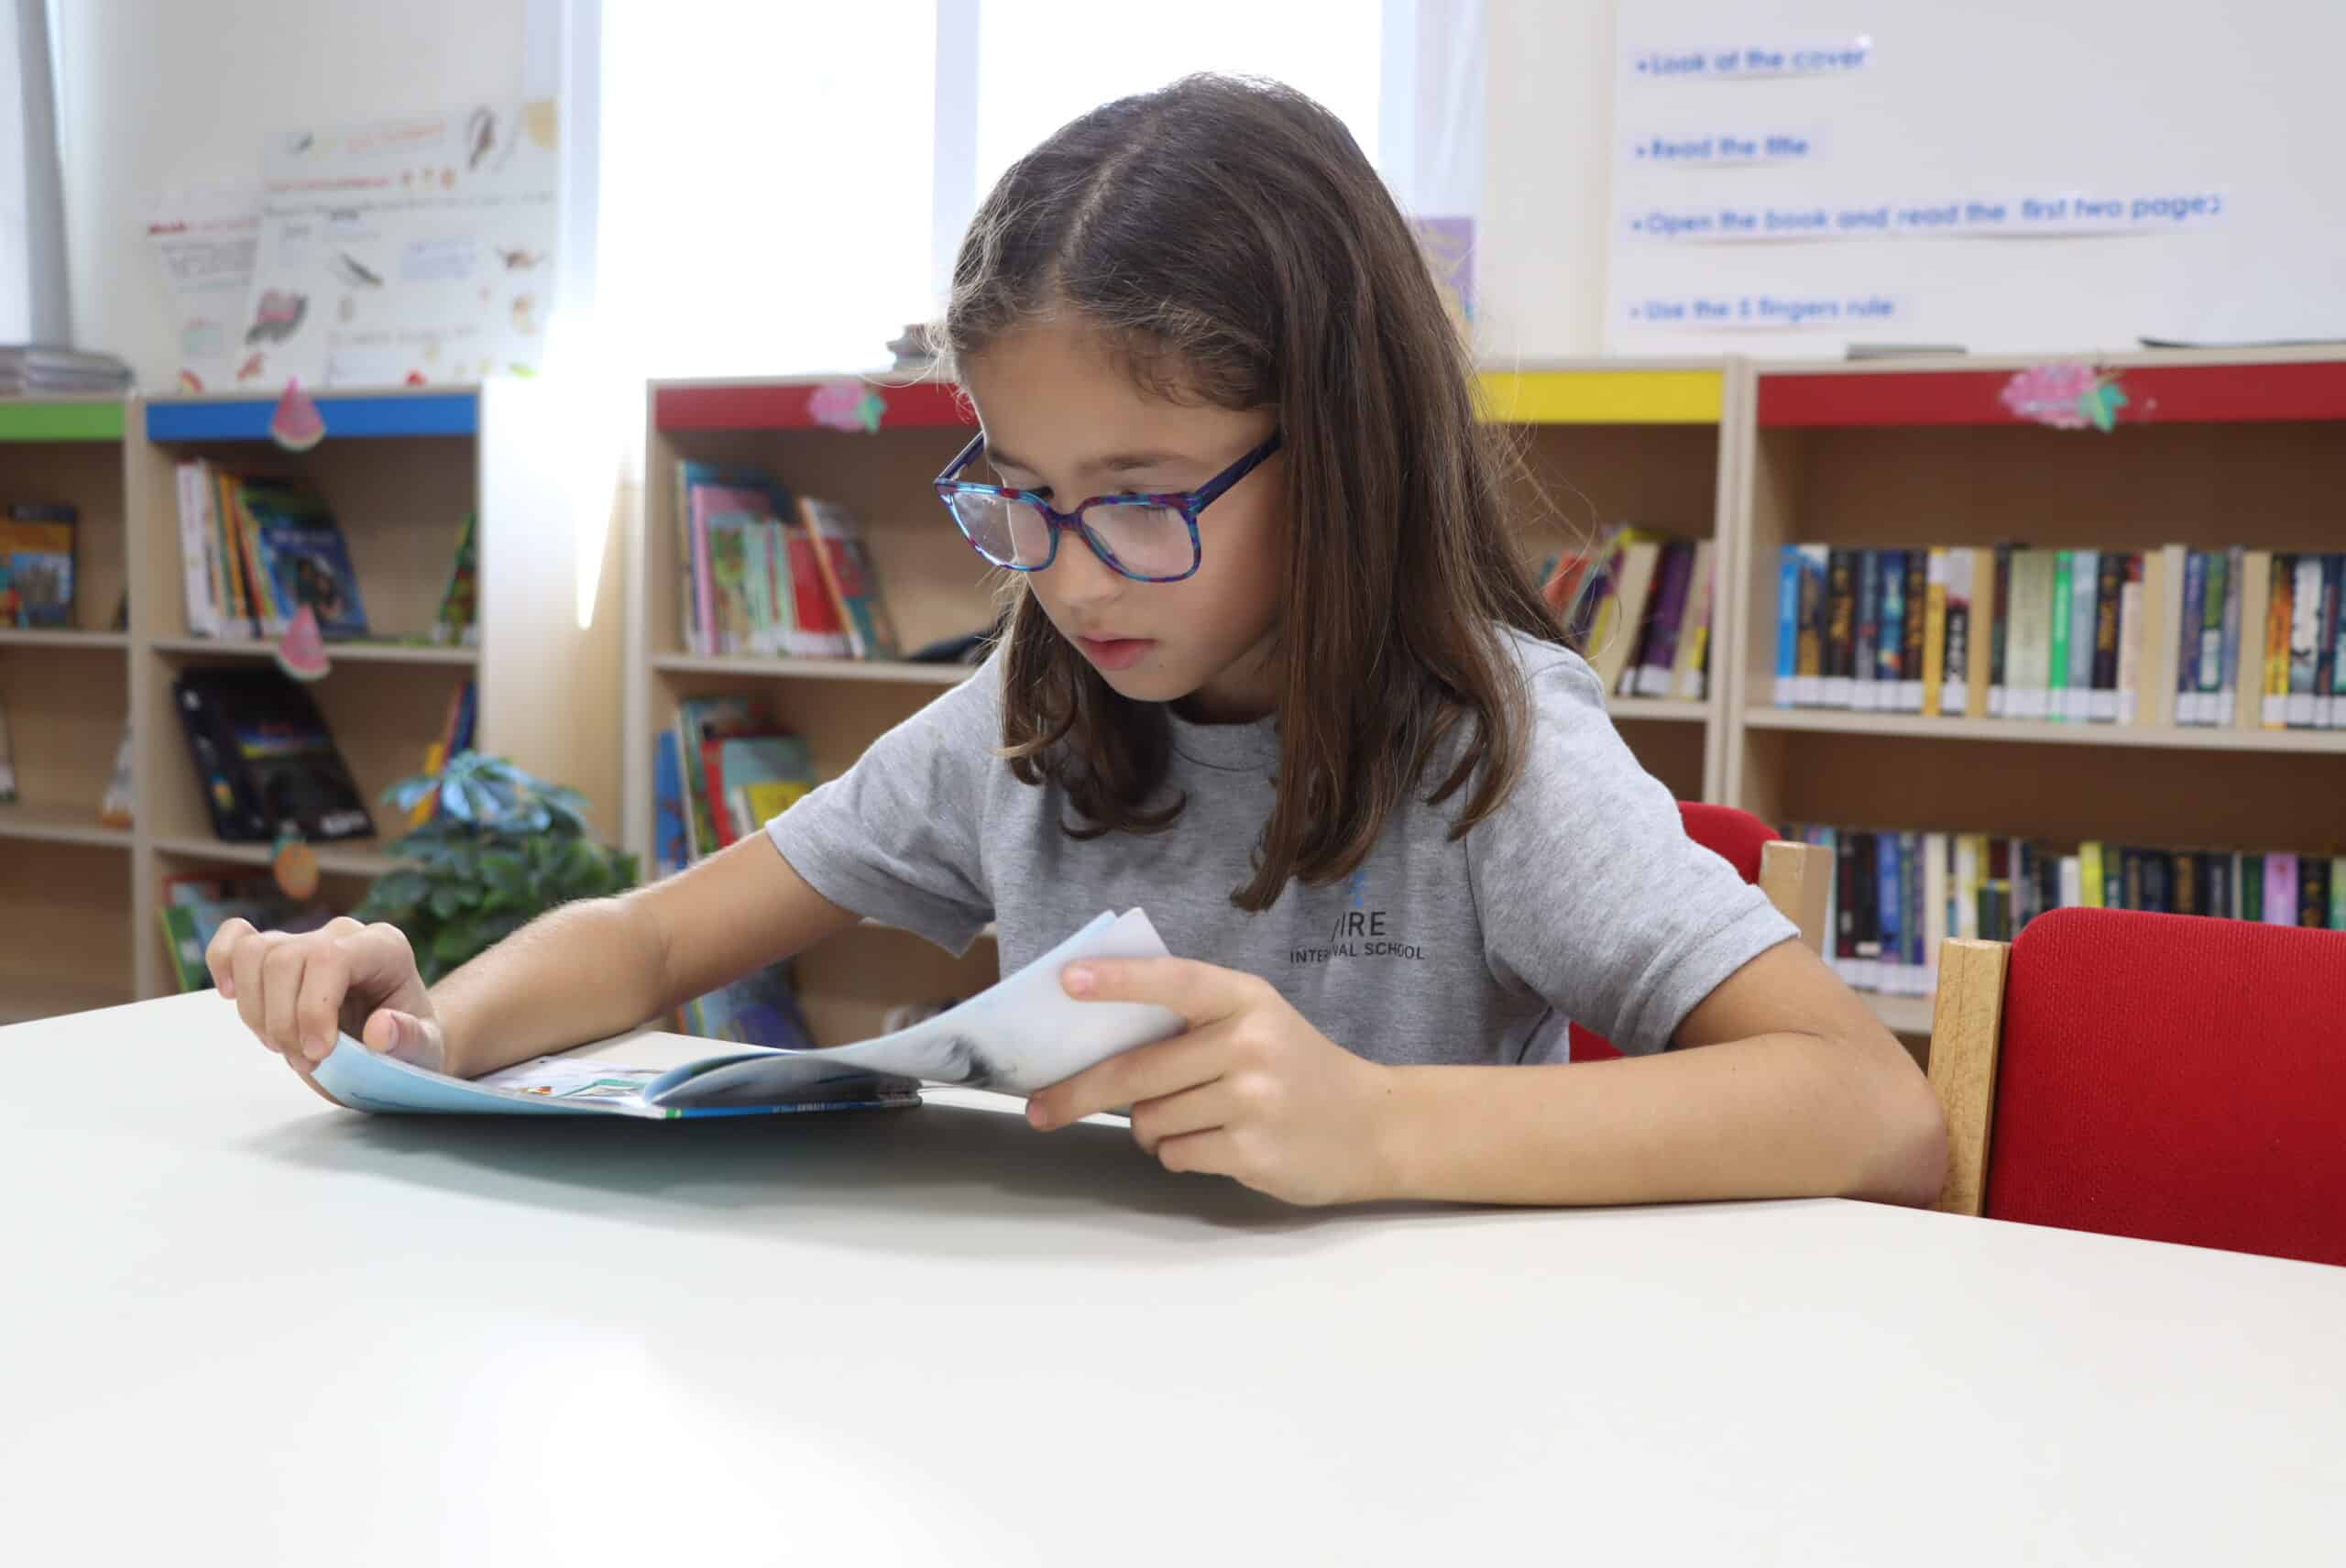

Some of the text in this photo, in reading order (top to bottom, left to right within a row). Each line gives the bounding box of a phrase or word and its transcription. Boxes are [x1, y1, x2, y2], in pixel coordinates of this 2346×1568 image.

[1745, 47, 1785, 71] the
[1650, 135, 1714, 159] Read
[1718, 135, 1758, 159] the
[1646, 210, 1712, 237] Open
[1719, 208, 1758, 231] the
[1765, 207, 1829, 230] book
[1836, 203, 1890, 229] and
[1897, 203, 1959, 226] read
[1965, 199, 2006, 224] the
[1692, 296, 1730, 319] the
[1365, 942, 1426, 960] SCHOOL
